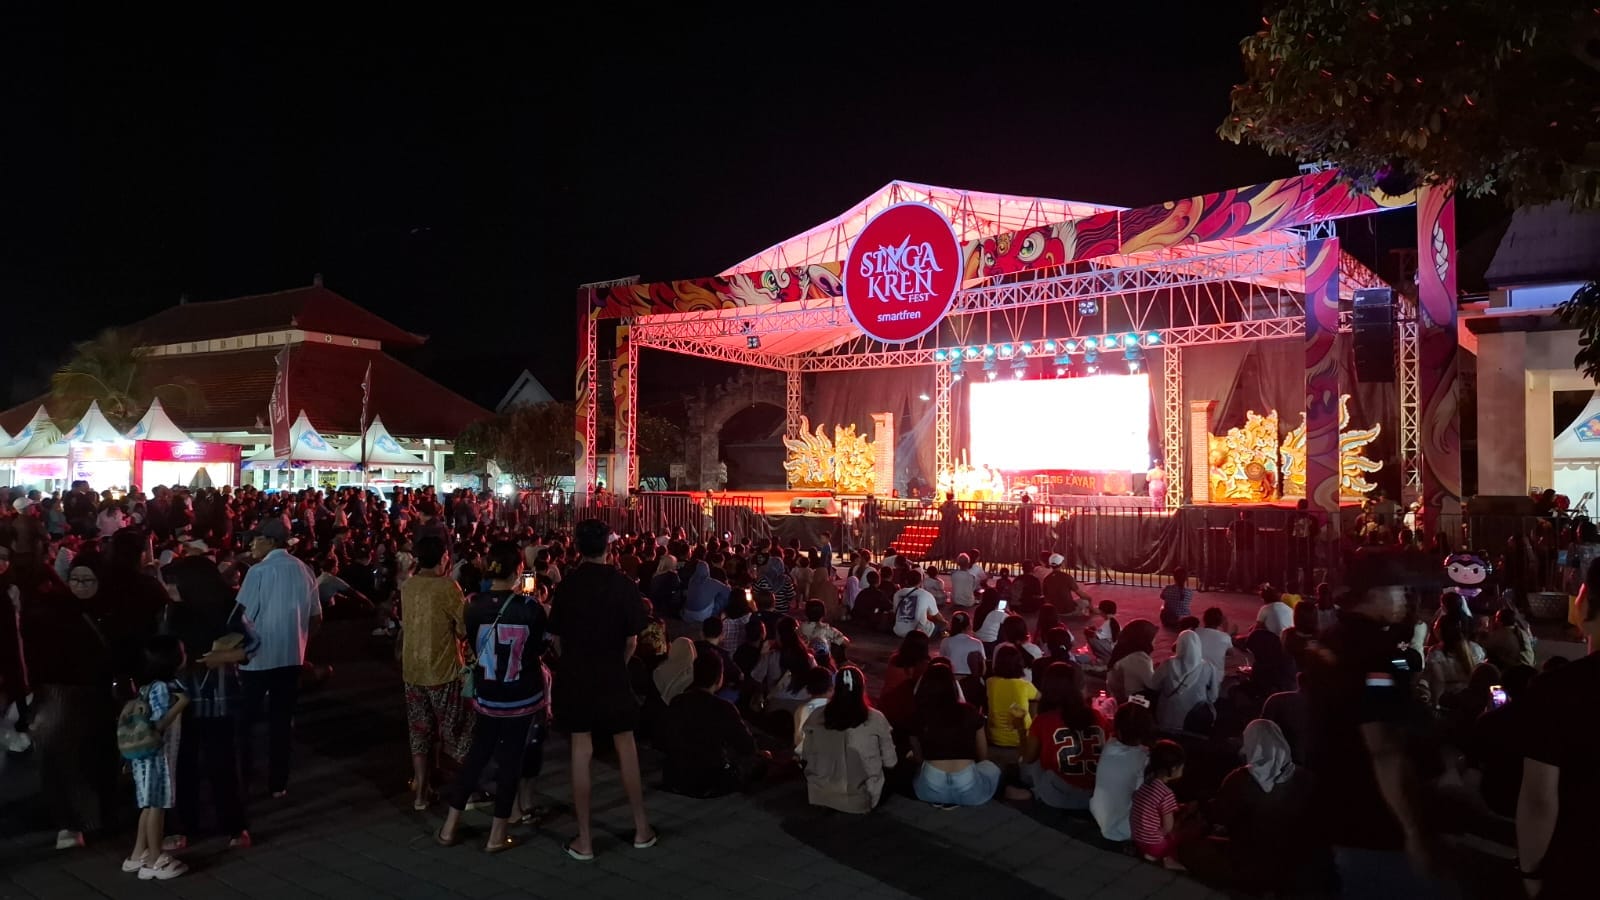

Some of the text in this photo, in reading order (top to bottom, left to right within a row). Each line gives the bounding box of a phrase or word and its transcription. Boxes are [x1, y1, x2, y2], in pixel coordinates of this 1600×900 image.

[860, 234, 943, 277] SINGA
[868, 269, 938, 303] KREN
[908, 292, 930, 303] FEST
[877, 309, 921, 322] smartfren
[1065, 475, 1096, 489] LAYAR
[1052, 725, 1106, 776] 23
